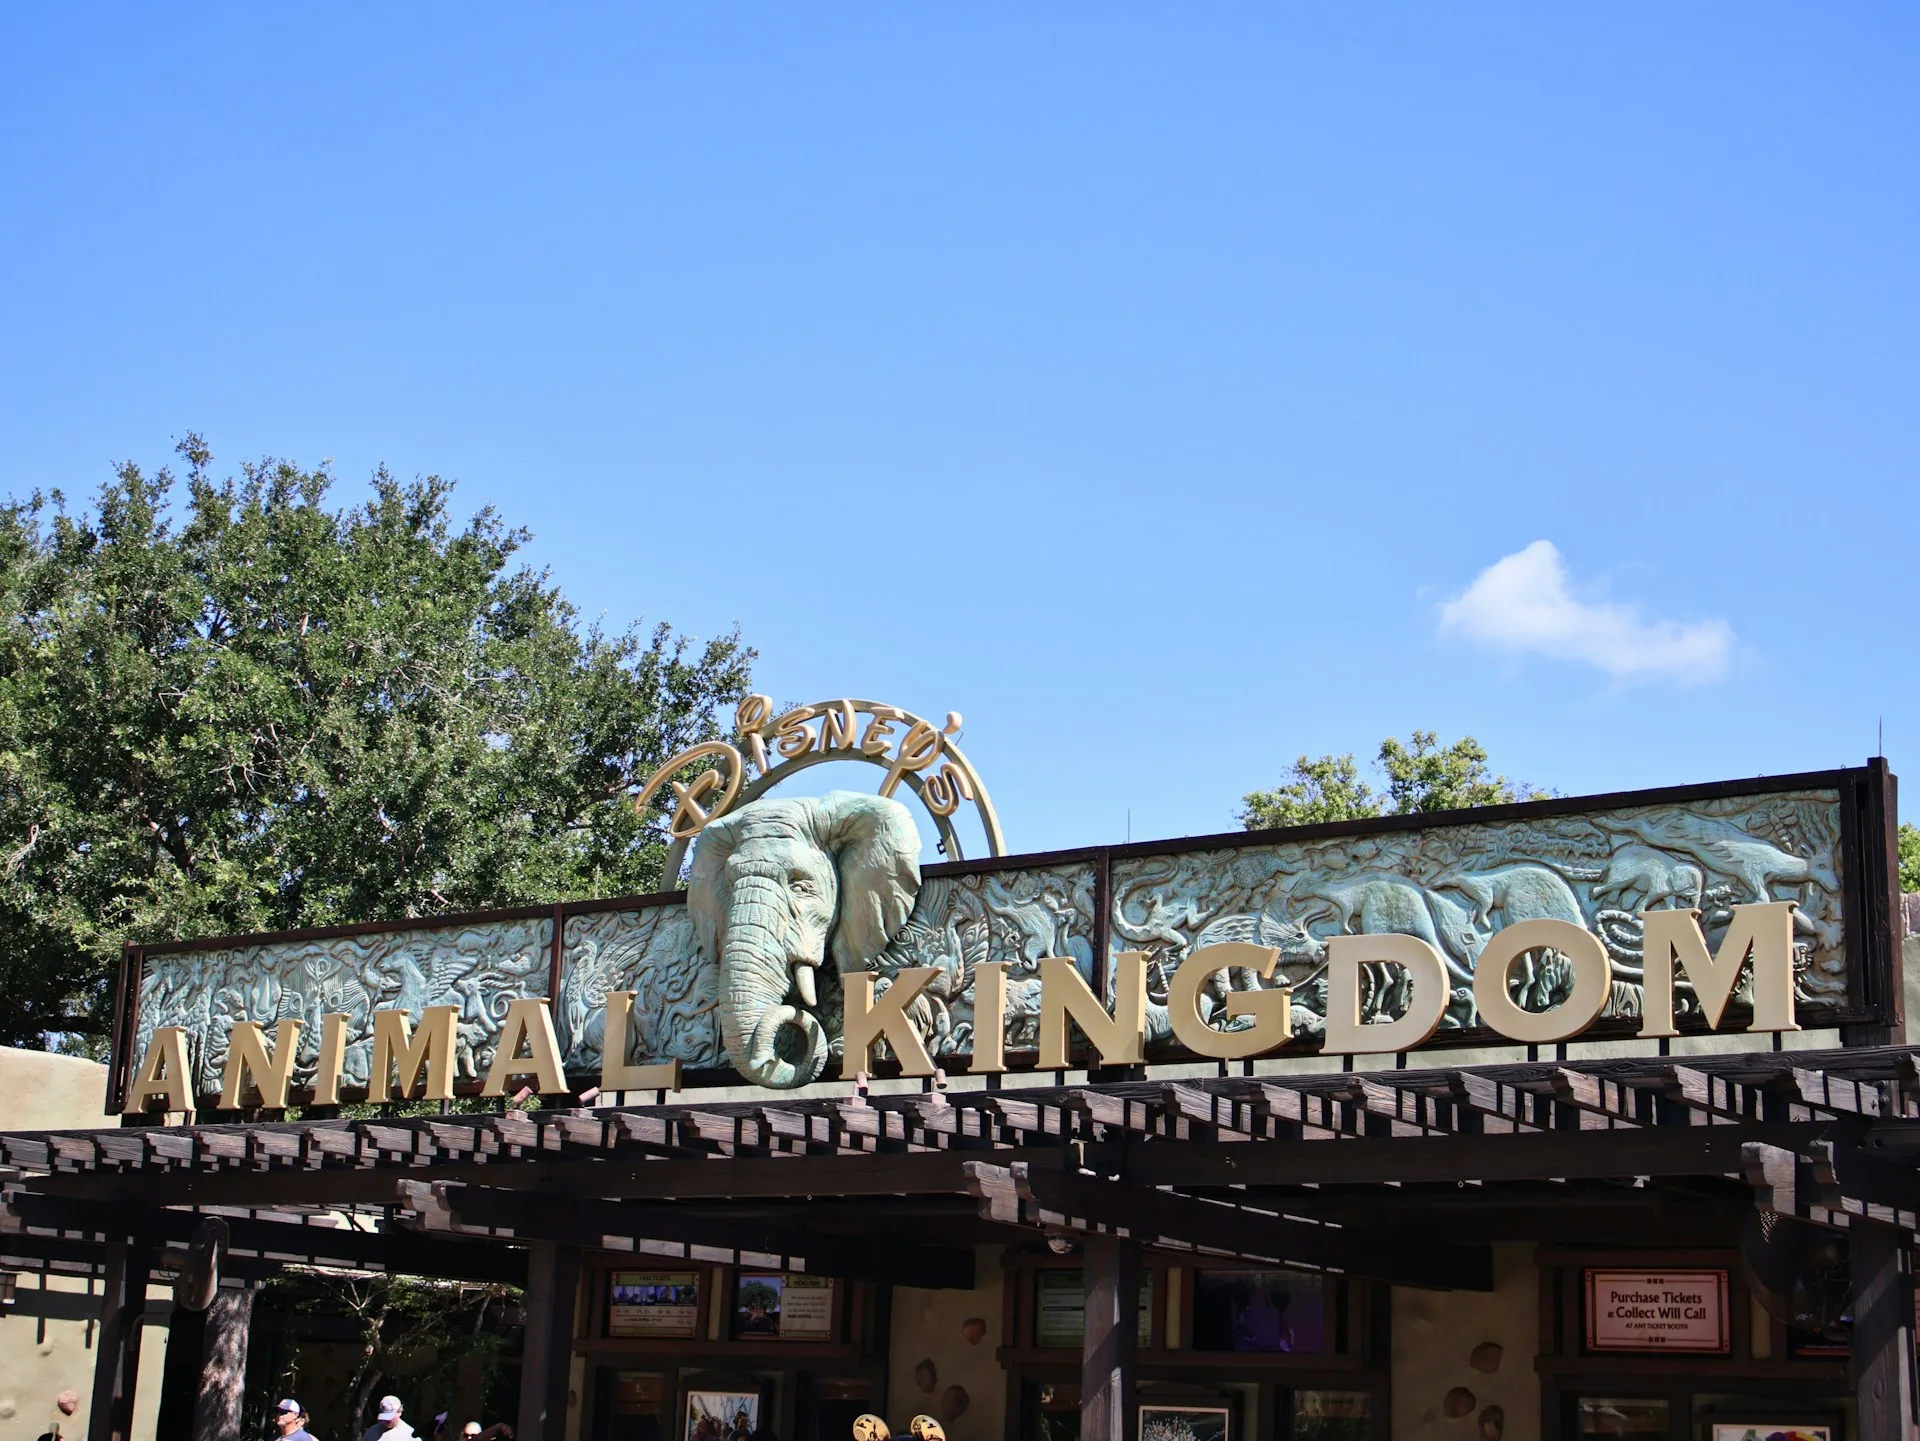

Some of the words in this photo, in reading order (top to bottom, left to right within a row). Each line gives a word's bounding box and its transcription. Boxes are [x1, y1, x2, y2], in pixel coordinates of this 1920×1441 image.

[122, 990, 682, 1114] ANIMAL
[838, 900, 1803, 1080] KINGDOM
[1610, 1291, 1660, 1304] Purchase
[1662, 1291, 1703, 1304] Tickets
[1616, 1306, 1655, 1319] Collect
[1657, 1307, 1681, 1319] Will
[1684, 1307, 1706, 1320] Call
